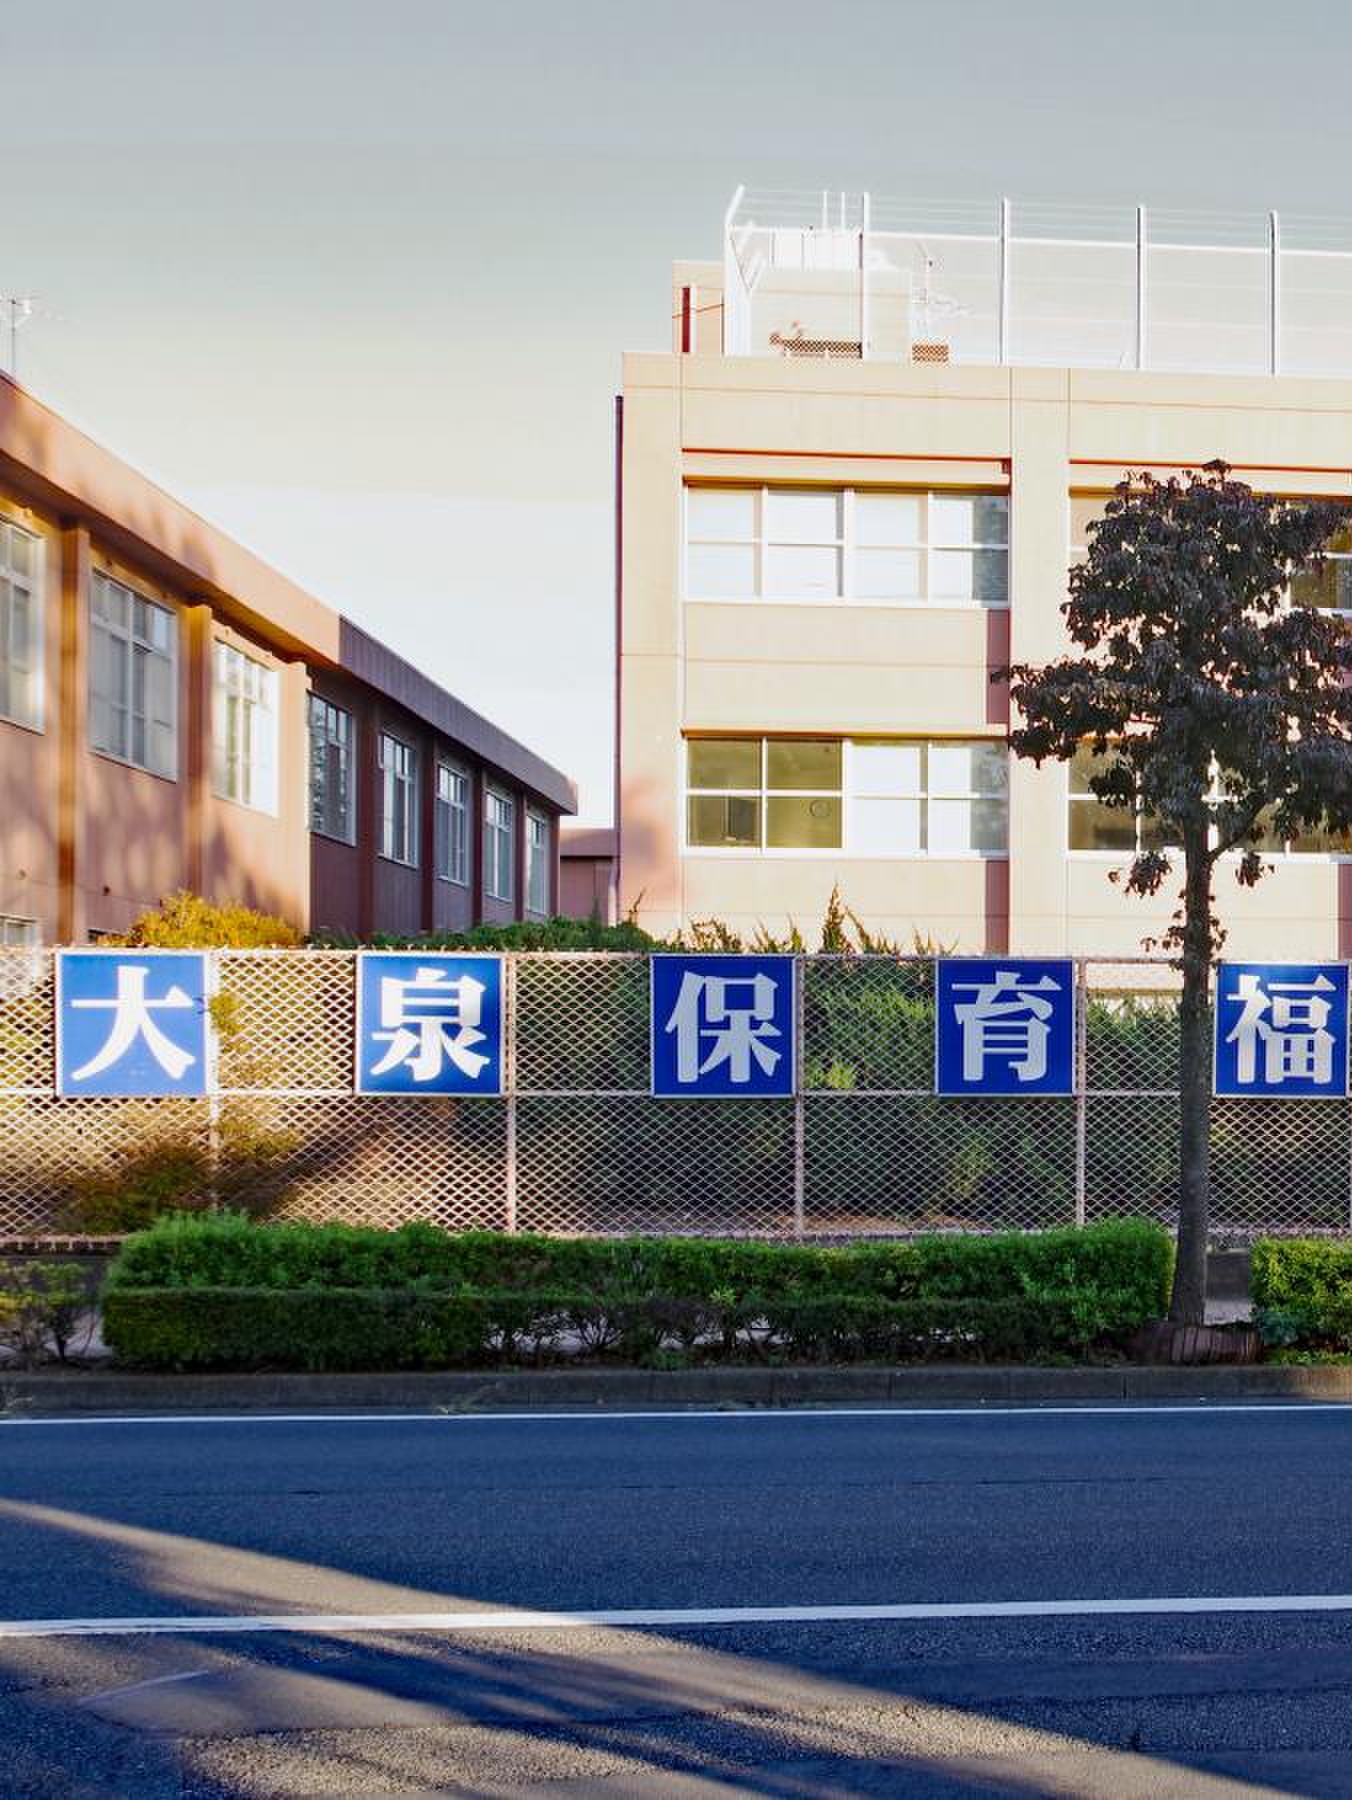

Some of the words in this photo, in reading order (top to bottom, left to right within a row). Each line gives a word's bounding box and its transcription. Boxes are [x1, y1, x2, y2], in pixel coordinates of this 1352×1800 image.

[71, 965, 196, 1082] 大
[370, 968, 490, 1082] 泉
[666, 971, 782, 1083] 保
[952, 971, 1062, 1082] 育
[1226, 974, 1337, 1084] 福
